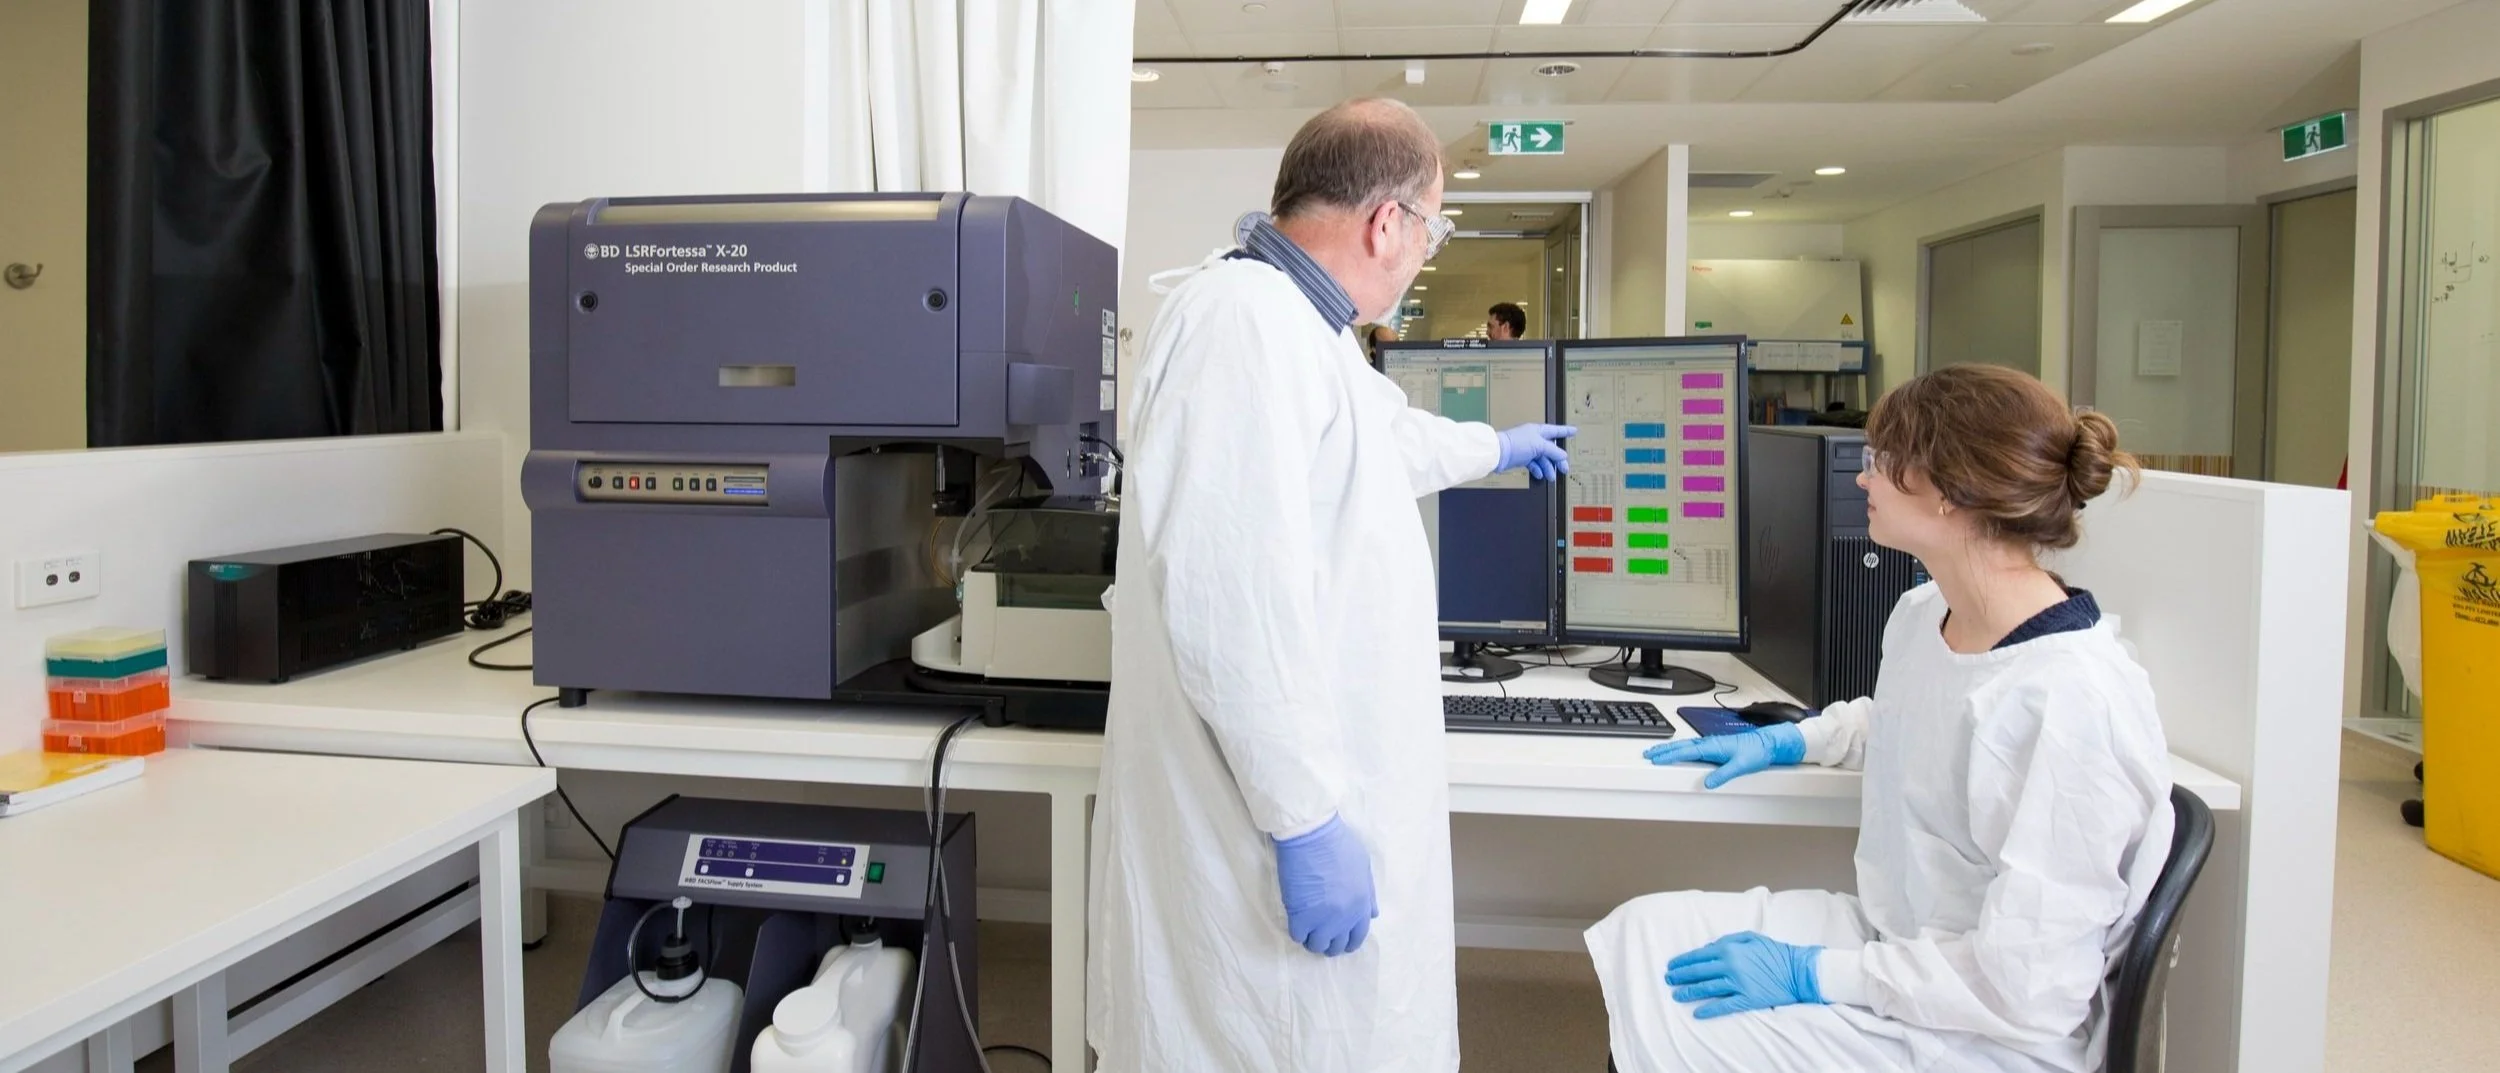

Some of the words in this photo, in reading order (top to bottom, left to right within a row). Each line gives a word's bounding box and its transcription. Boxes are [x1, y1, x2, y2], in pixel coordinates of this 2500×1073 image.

[600, 245, 620, 258] BD
[716, 244, 748, 257] X-20
[625, 262, 663, 275] Special
[666, 262, 698, 273] Order
[701, 261, 751, 273] Research
[754, 261, 798, 272] Product
[1863, 552, 1879, 568] hp
[727, 880, 744, 888] Supply
